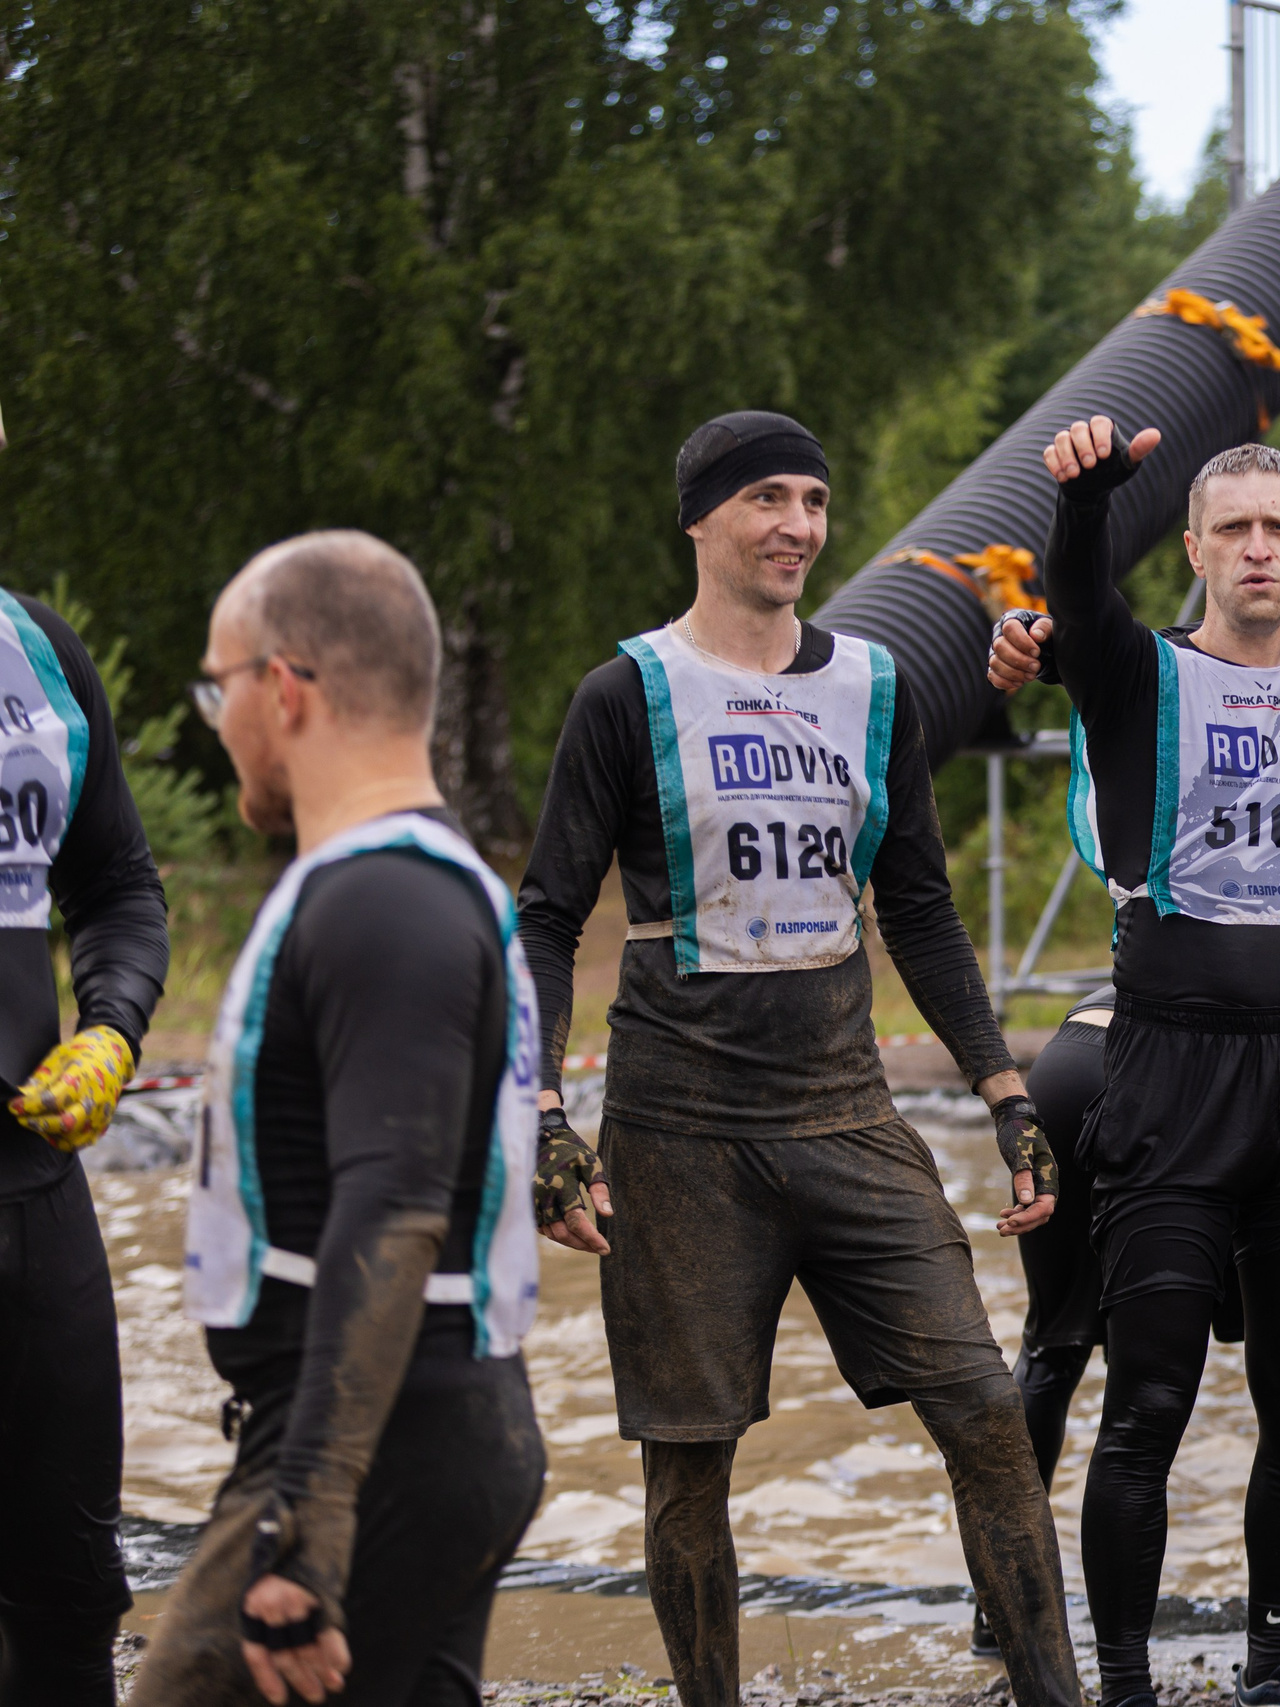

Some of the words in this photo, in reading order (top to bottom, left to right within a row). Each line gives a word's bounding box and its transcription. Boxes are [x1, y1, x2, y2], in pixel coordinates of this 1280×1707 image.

[726, 700, 773, 711] ГОНКА
[1222, 694, 1265, 705] ГОНКА
[715, 742, 851, 787] RODVIG
[727, 822, 848, 881] 6120
[775, 920, 839, 934] ГАЗПРОМБАНК
